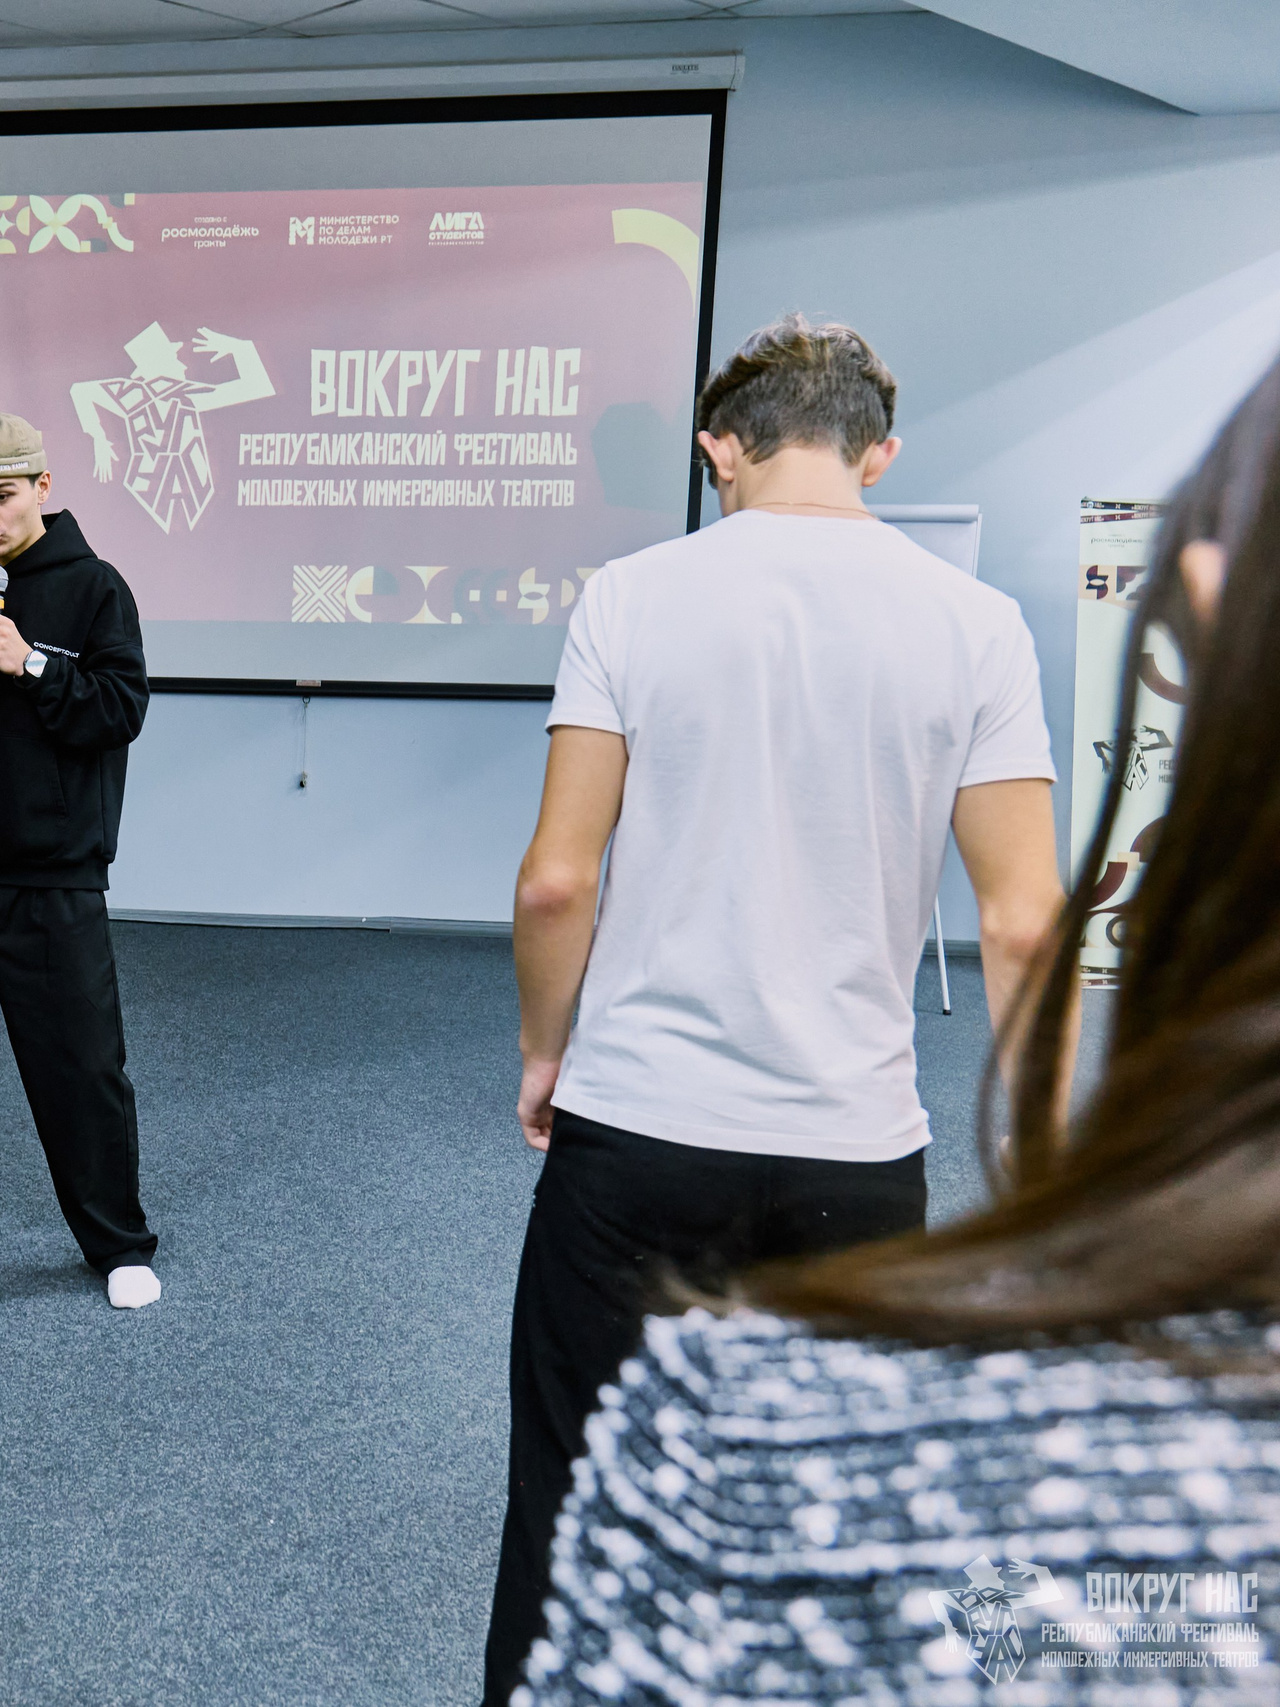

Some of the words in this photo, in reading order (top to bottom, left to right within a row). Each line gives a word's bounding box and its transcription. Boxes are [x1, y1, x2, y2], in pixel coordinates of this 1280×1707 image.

[319, 214, 400, 226] МИНИСТЕРСТВО
[429, 211, 485, 231] ЛИГА
[161, 224, 260, 243] росмолодёжь
[319, 226, 334, 236] ПО
[336, 225, 371, 236] ДЕЛАМ
[318, 235, 377, 247] МОЛОДЕЖИ
[380, 234, 393, 245] РТ
[310, 348, 481, 418] ВОКРУГ
[494, 345, 581, 417] НАС
[238, 429, 447, 466] РЕСПУБЛИКАНСКИЙ
[453, 431, 578, 466] ФЕСТИВАЛЬ
[237, 478, 358, 507] МОЛОДЕЖНЫХ
[362, 478, 496, 507] ИММЕРСИВНЫХ
[500, 478, 575, 507] ТЕАТРОВ
